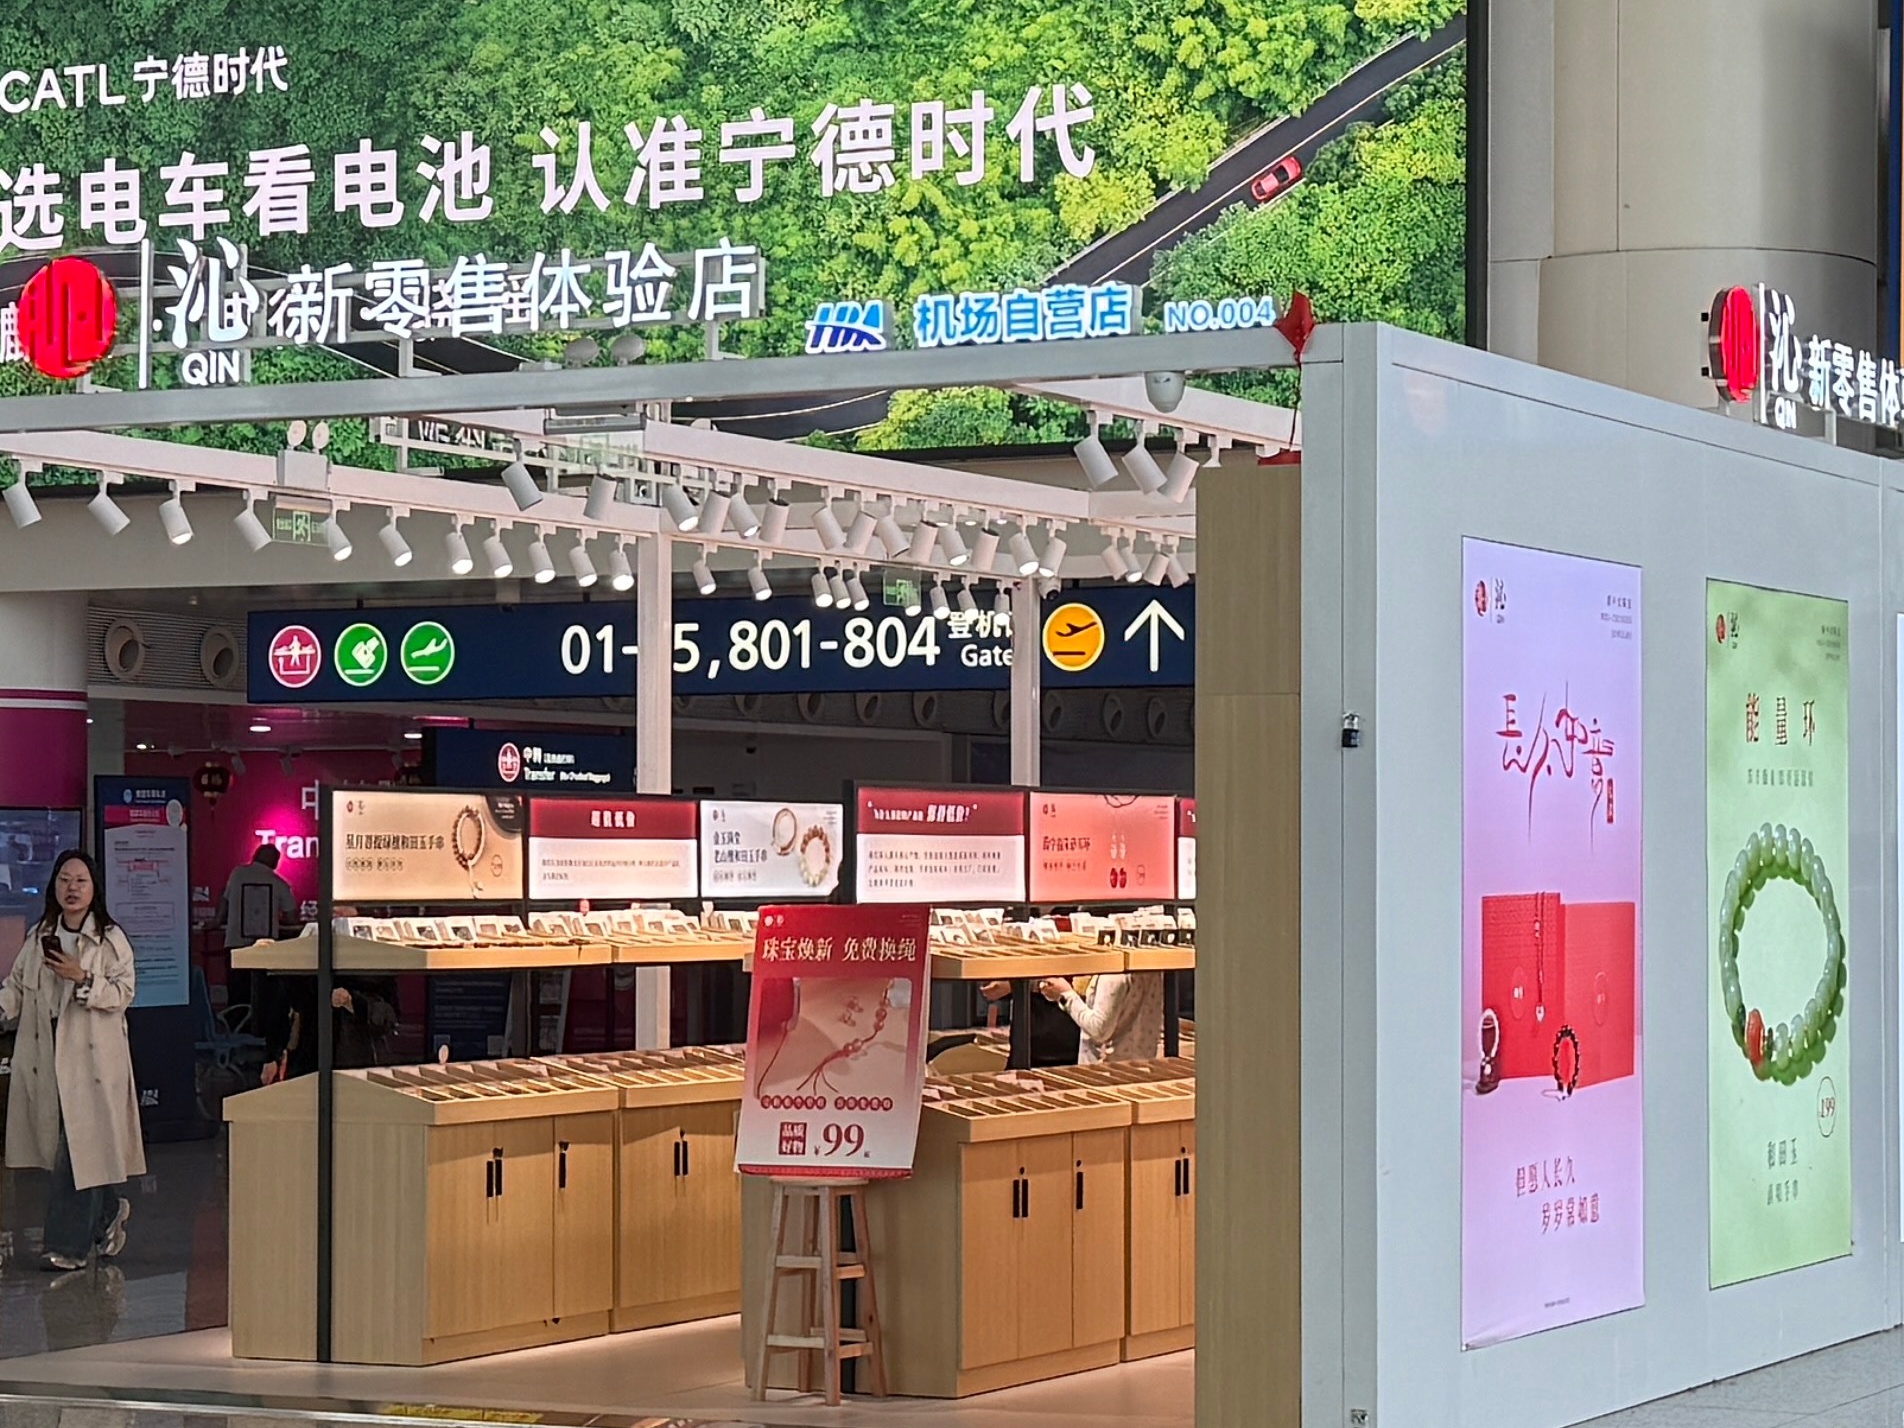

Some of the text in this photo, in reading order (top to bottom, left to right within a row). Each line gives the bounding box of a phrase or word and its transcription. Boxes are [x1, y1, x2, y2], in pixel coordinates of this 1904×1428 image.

[131, 45, 289, 104] 宁德时代
[531, 80, 1097, 216] 认准宁德时代
[284, 236, 760, 346] 新零售体验店
[912, 284, 1132, 348] 机场自营店
[1163, 295, 1276, 333] NO.004
[182, 349, 242, 386] QIN
[561, 615, 941, 679] 01-5,801-804
